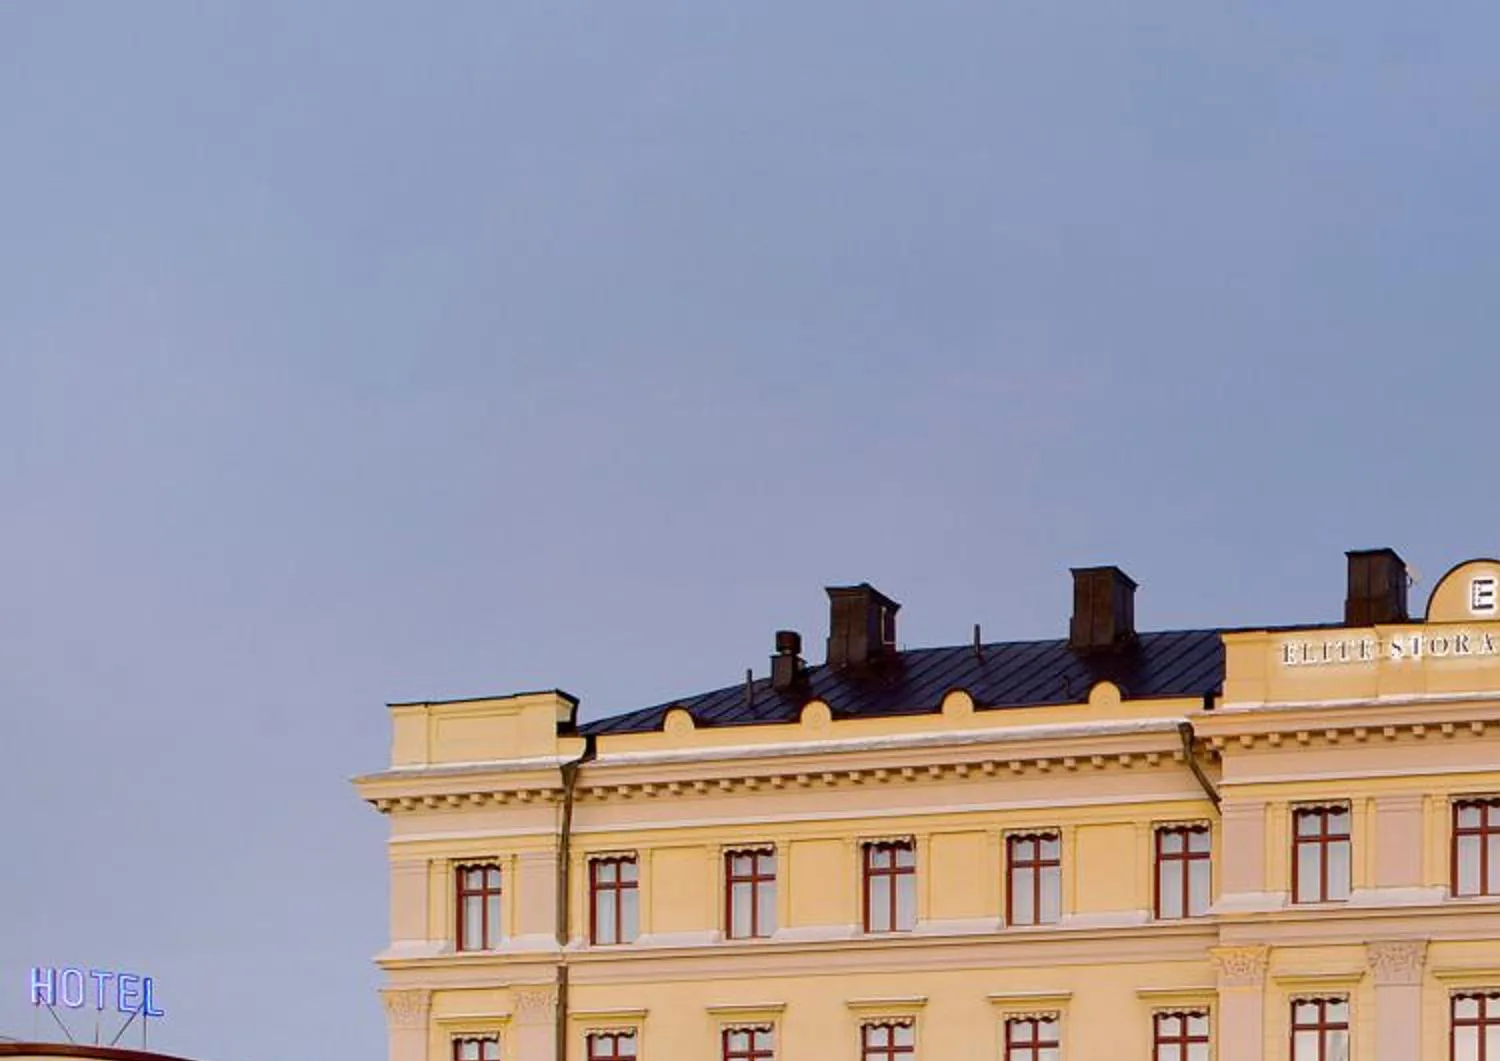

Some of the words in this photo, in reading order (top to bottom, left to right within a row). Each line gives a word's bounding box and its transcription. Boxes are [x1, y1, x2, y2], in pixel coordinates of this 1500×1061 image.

[1282, 637, 1375, 666] ELITE
[1390, 631, 1497, 661] STORA
[31, 967, 165, 1017] HOTEL
